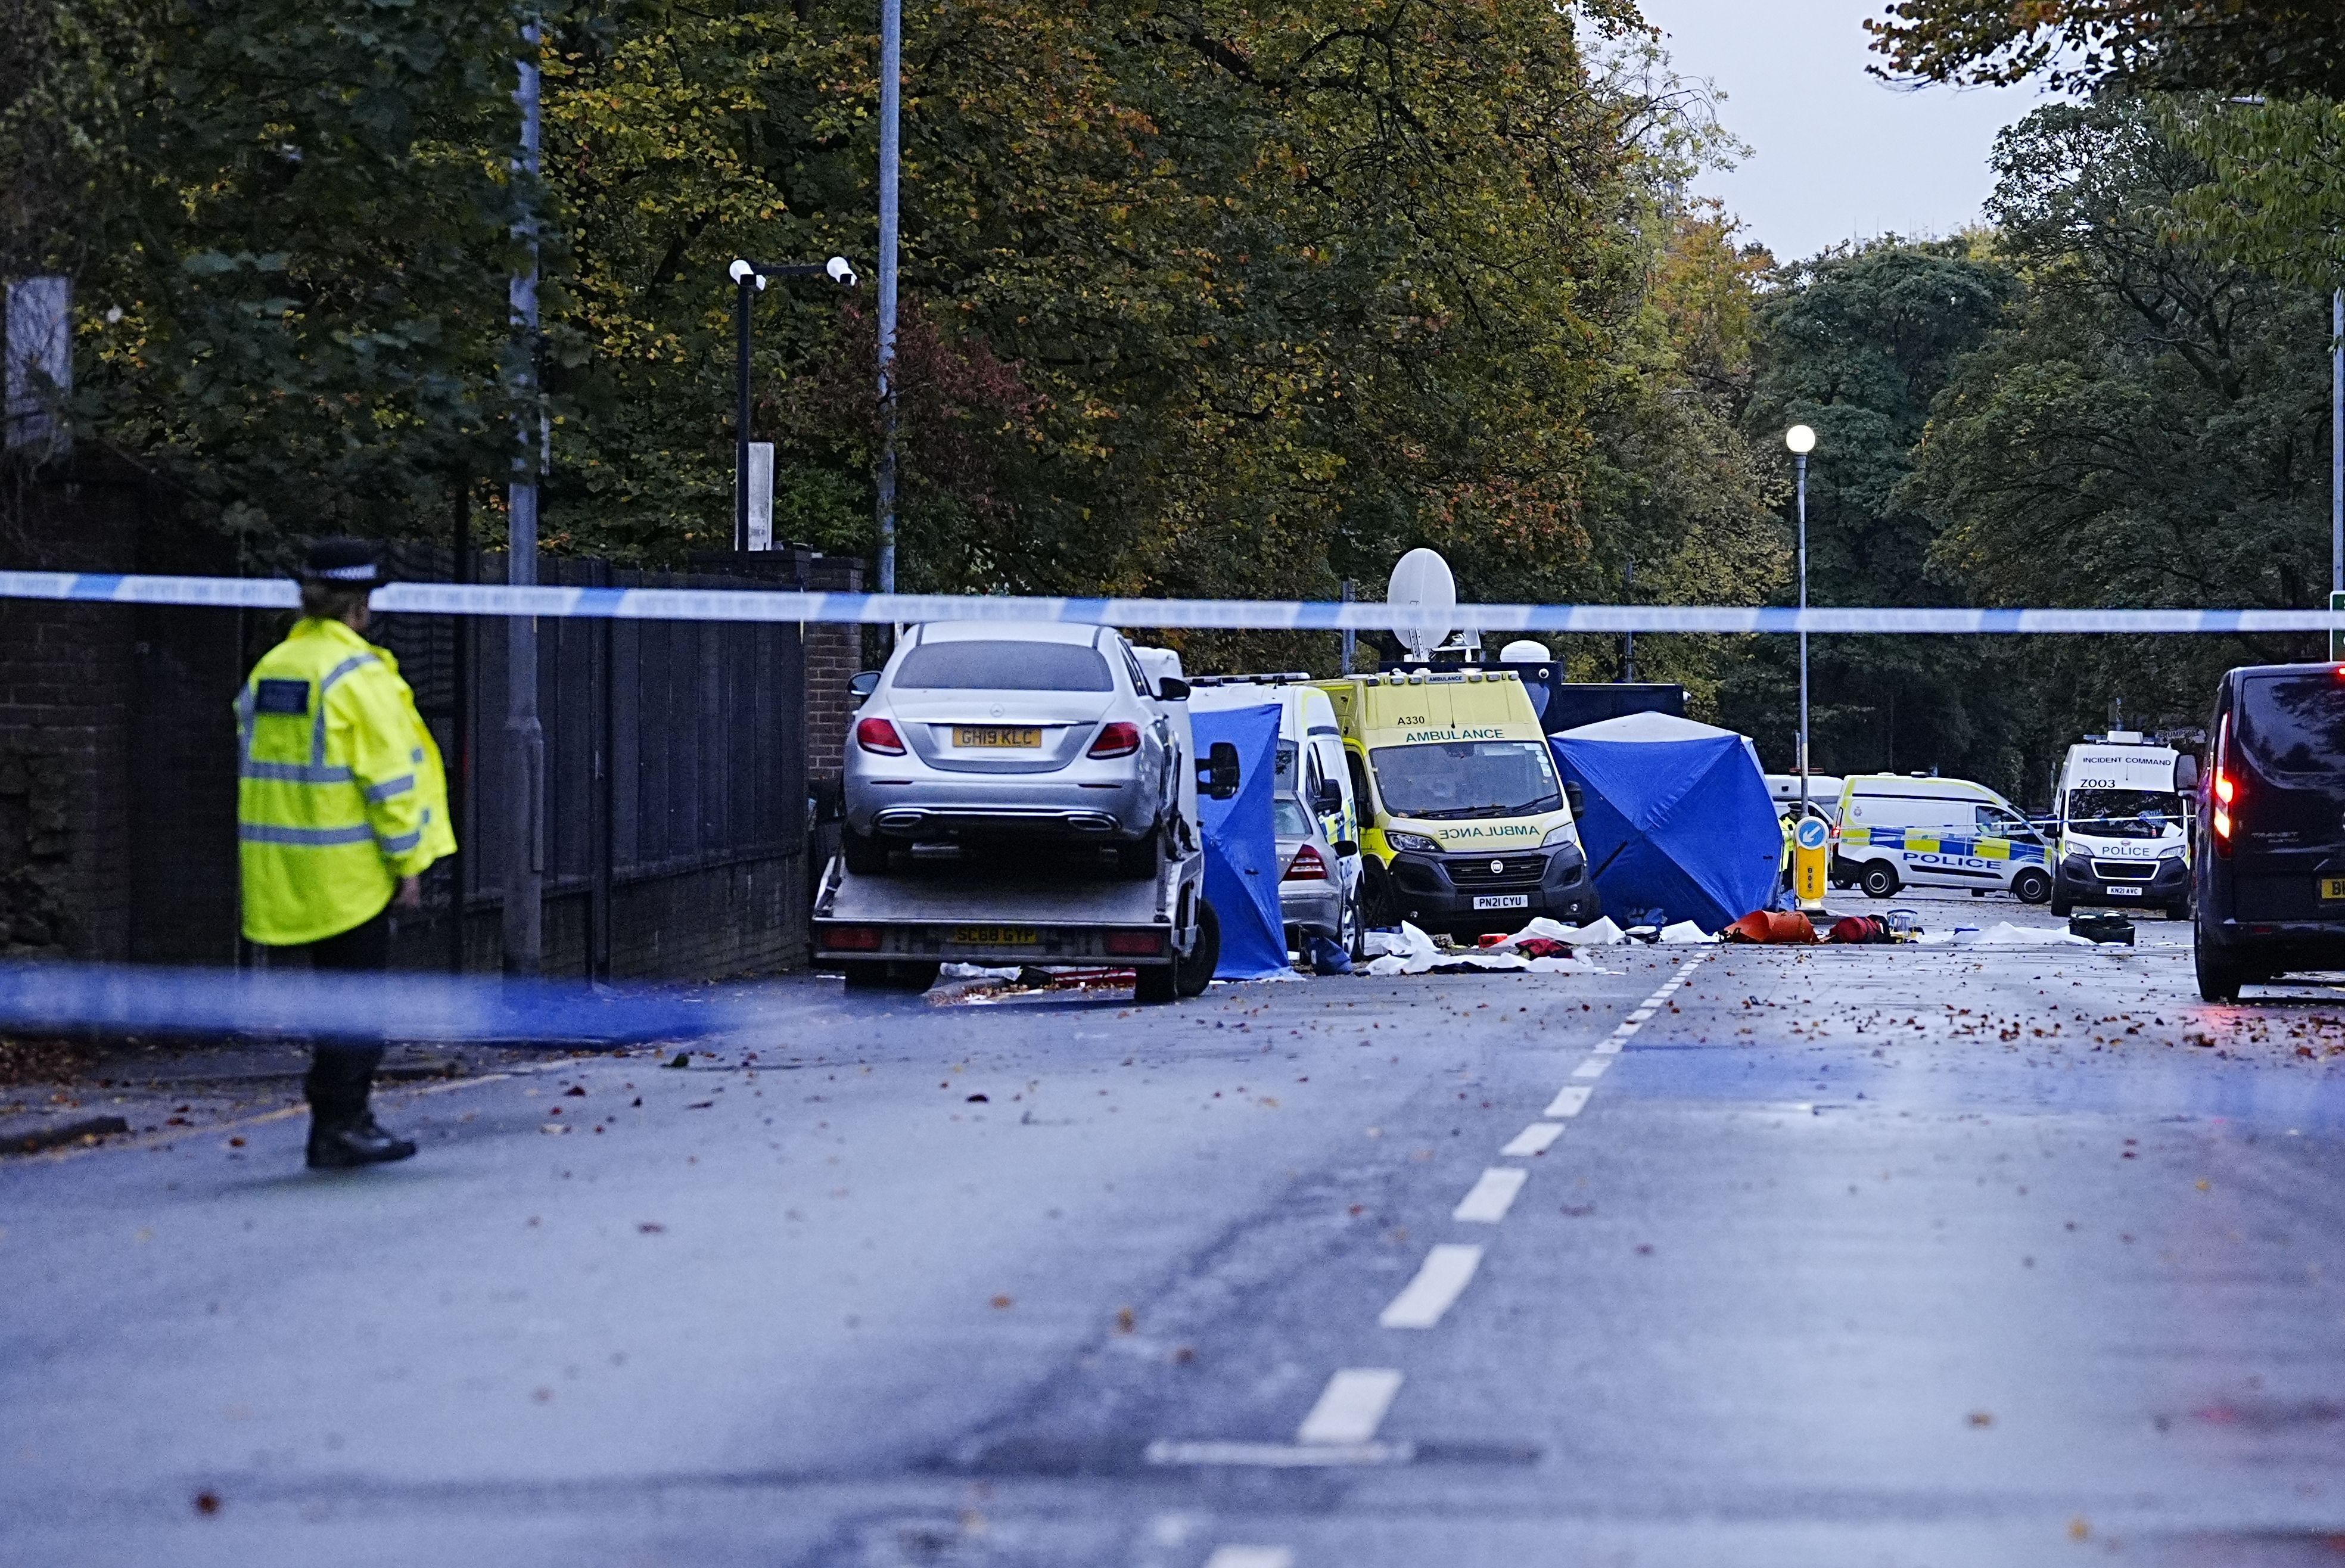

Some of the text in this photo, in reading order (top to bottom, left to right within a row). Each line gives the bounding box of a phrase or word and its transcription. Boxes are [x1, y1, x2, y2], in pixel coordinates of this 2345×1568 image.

[1397, 716, 1425, 725] A330
[962, 730, 1032, 745] GH19 KLC
[1406, 729, 1506, 743] AMBULANCE
[2125, 757, 2171, 766] COMMAND
[2080, 779, 2116, 788] Z003
[2102, 847, 2150, 856] POLICE
[1903, 853, 2002, 869] POLICE
[1479, 897, 1521, 907] PN21 CYU
